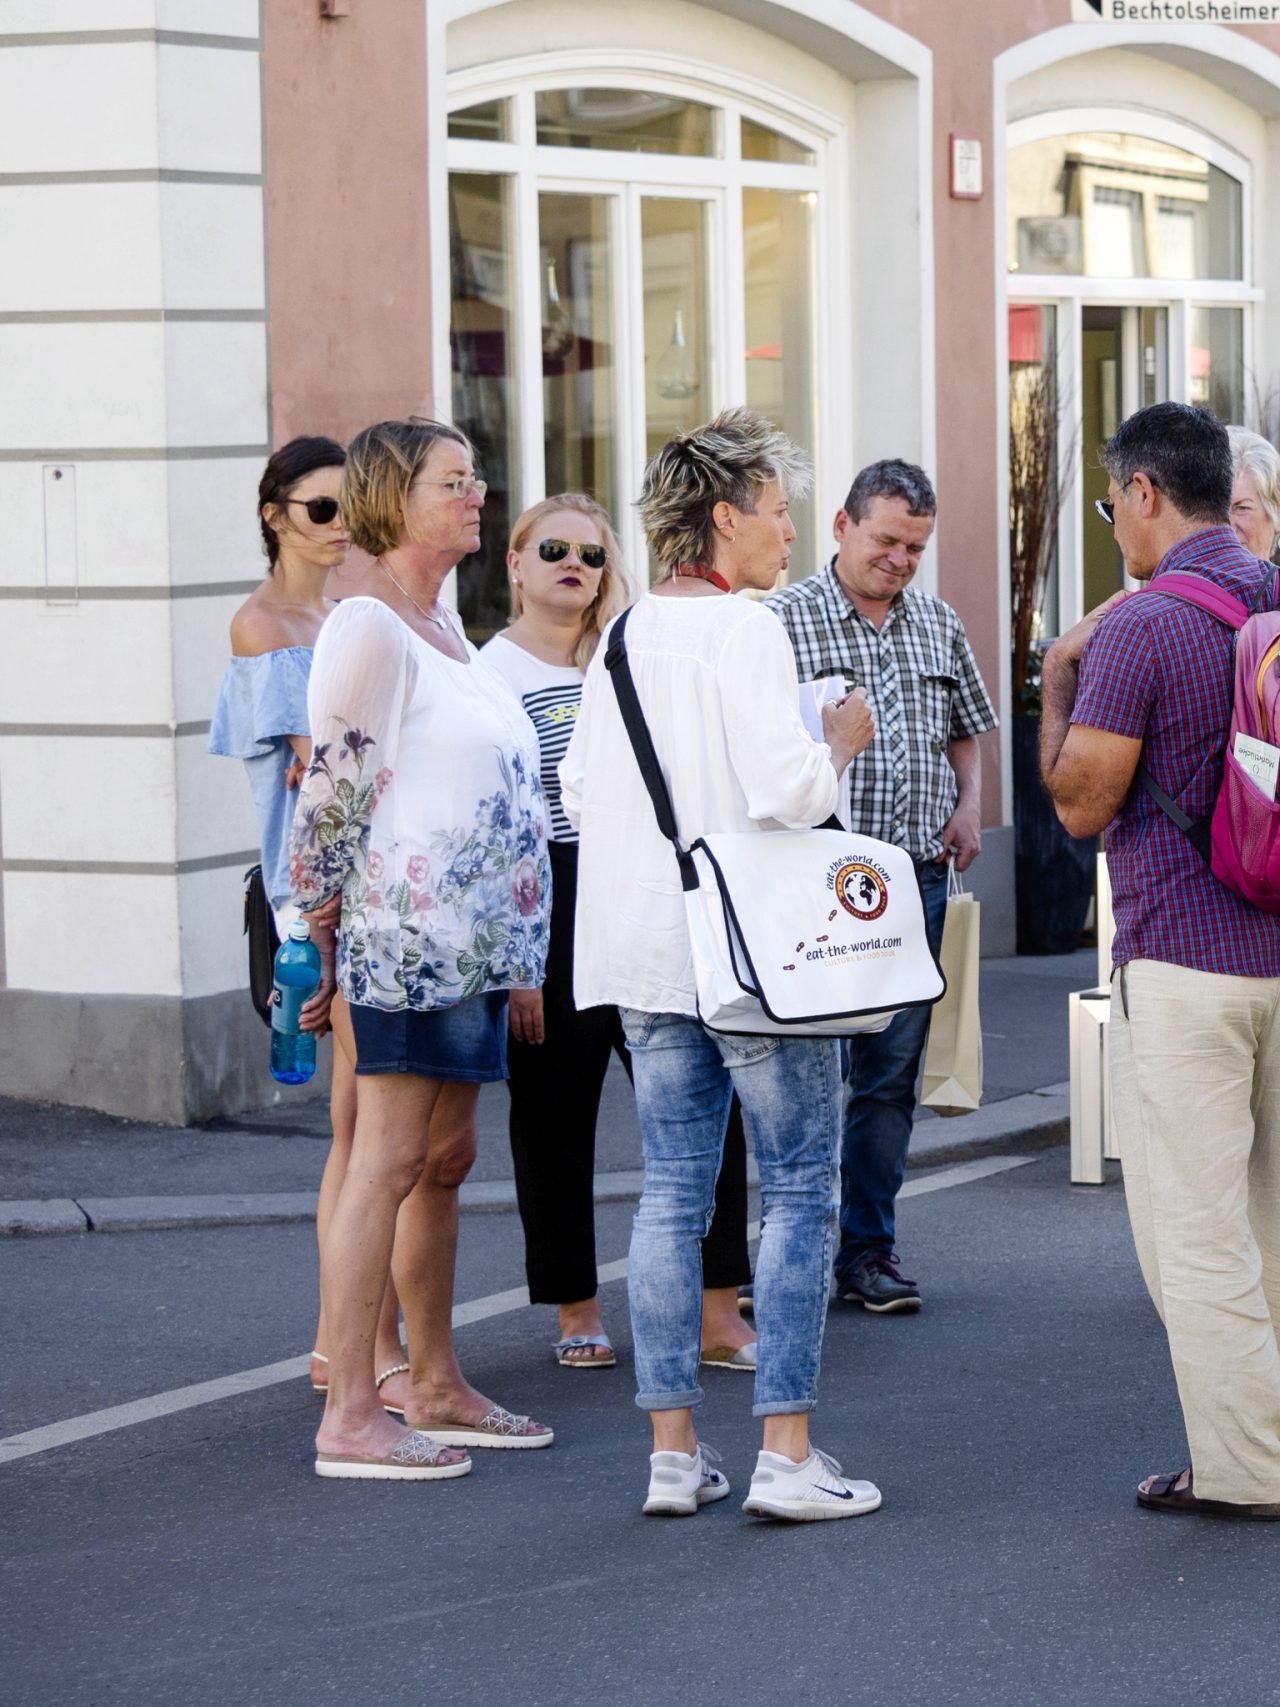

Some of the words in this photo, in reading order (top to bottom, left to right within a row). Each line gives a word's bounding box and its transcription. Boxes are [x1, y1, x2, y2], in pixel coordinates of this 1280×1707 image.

[1112, 1, 1280, 20] Bechtolsheimer
[826, 855, 892, 890] eat-the-world.com
[806, 937, 902, 961] eat-the-world.com
